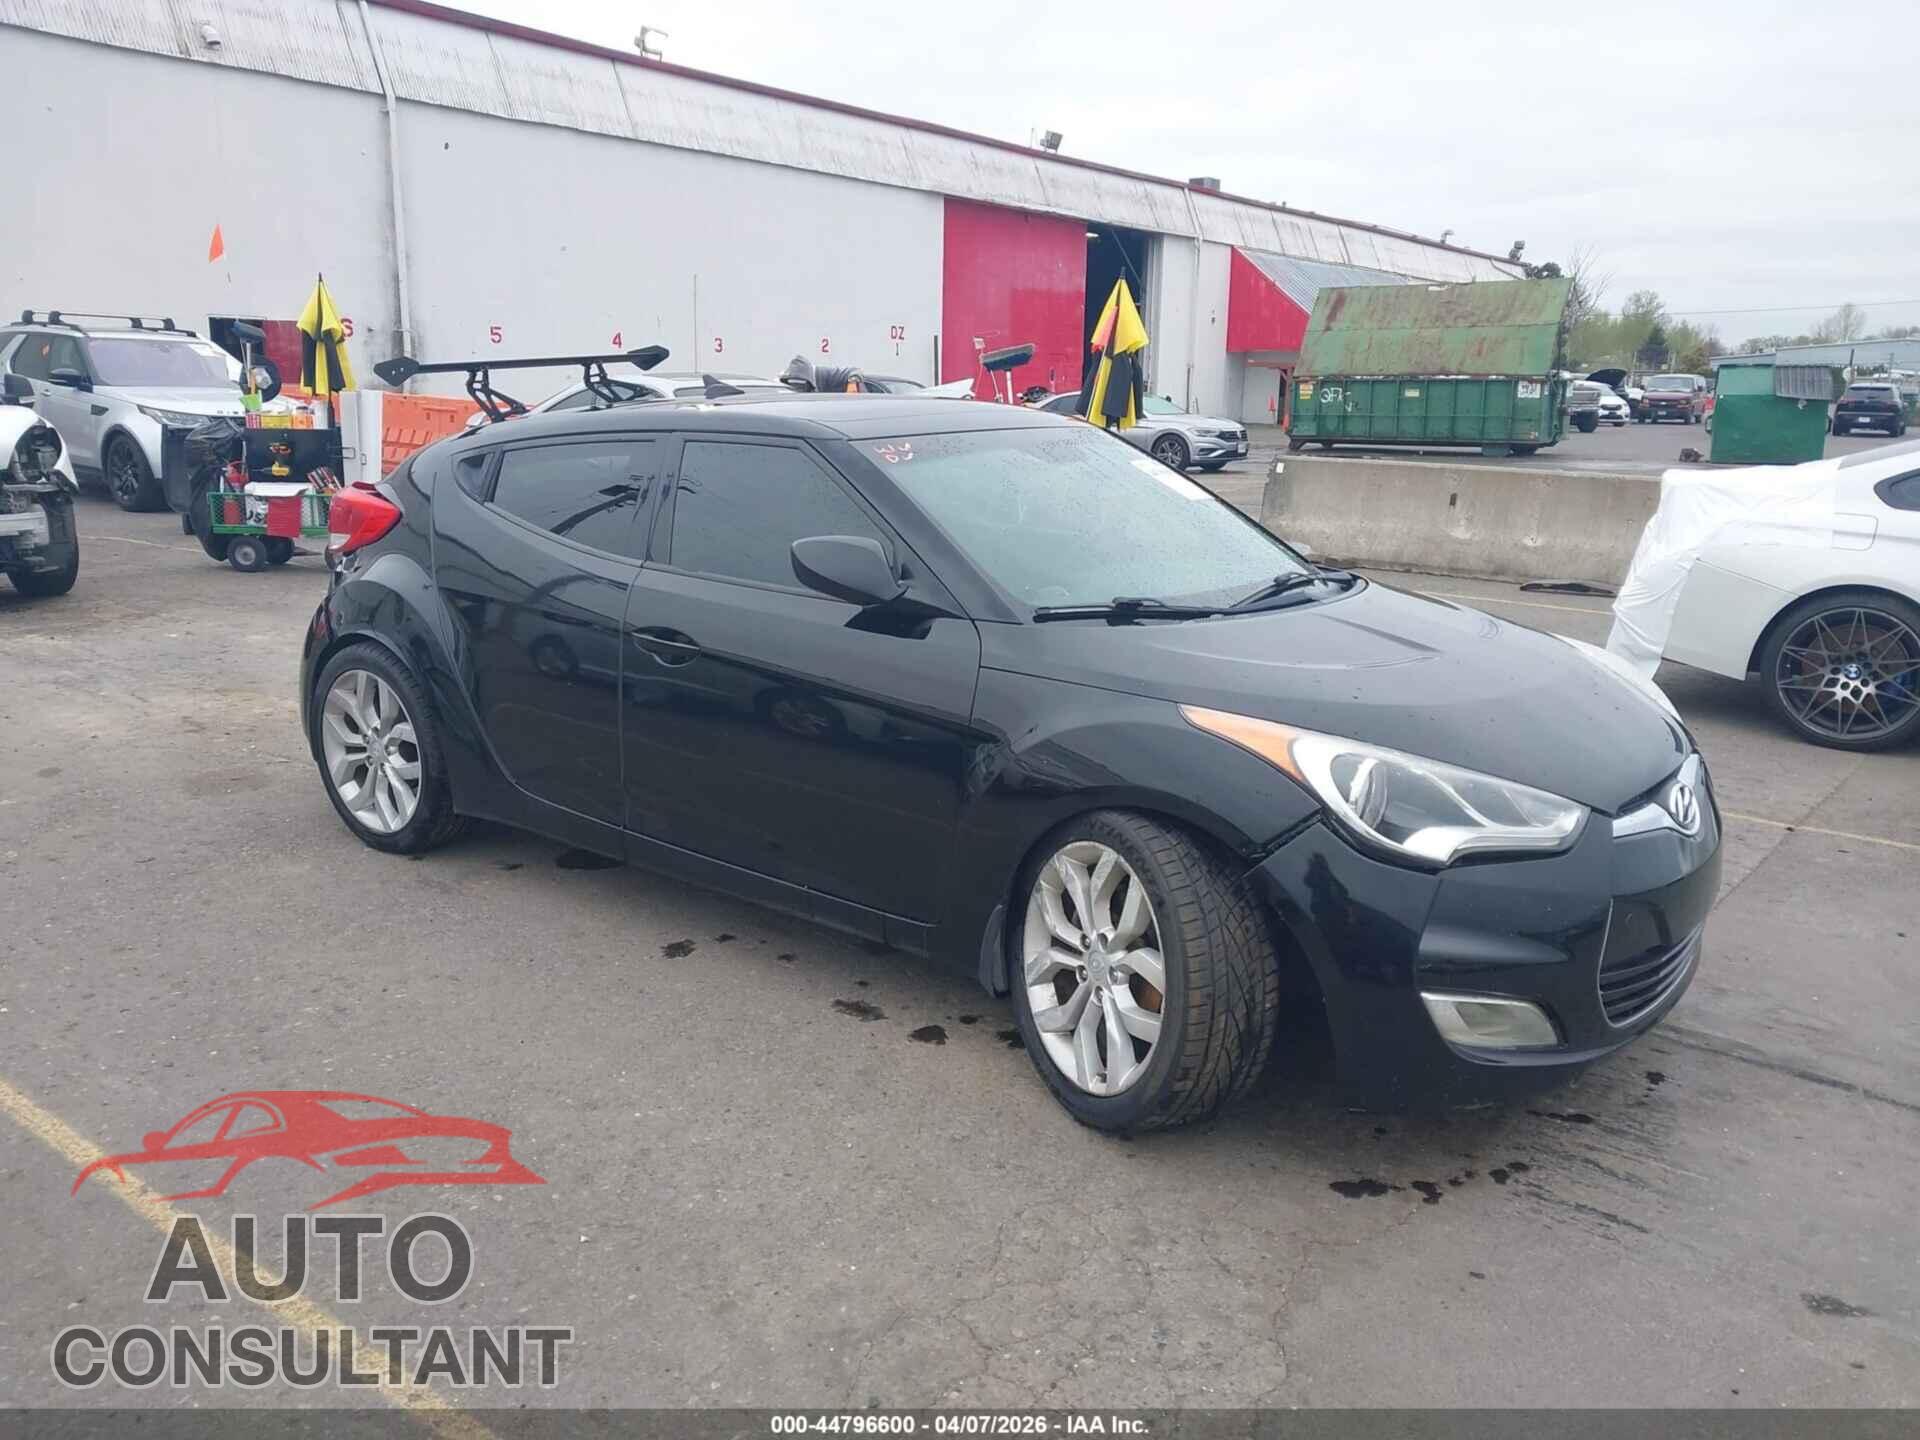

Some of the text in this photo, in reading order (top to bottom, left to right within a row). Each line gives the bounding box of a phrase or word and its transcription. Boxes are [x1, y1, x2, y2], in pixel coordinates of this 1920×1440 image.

[490, 326, 502, 343] 5
[612, 332, 622, 348] 4
[714, 337, 723, 352] 3
[821, 338, 830, 353] 2
